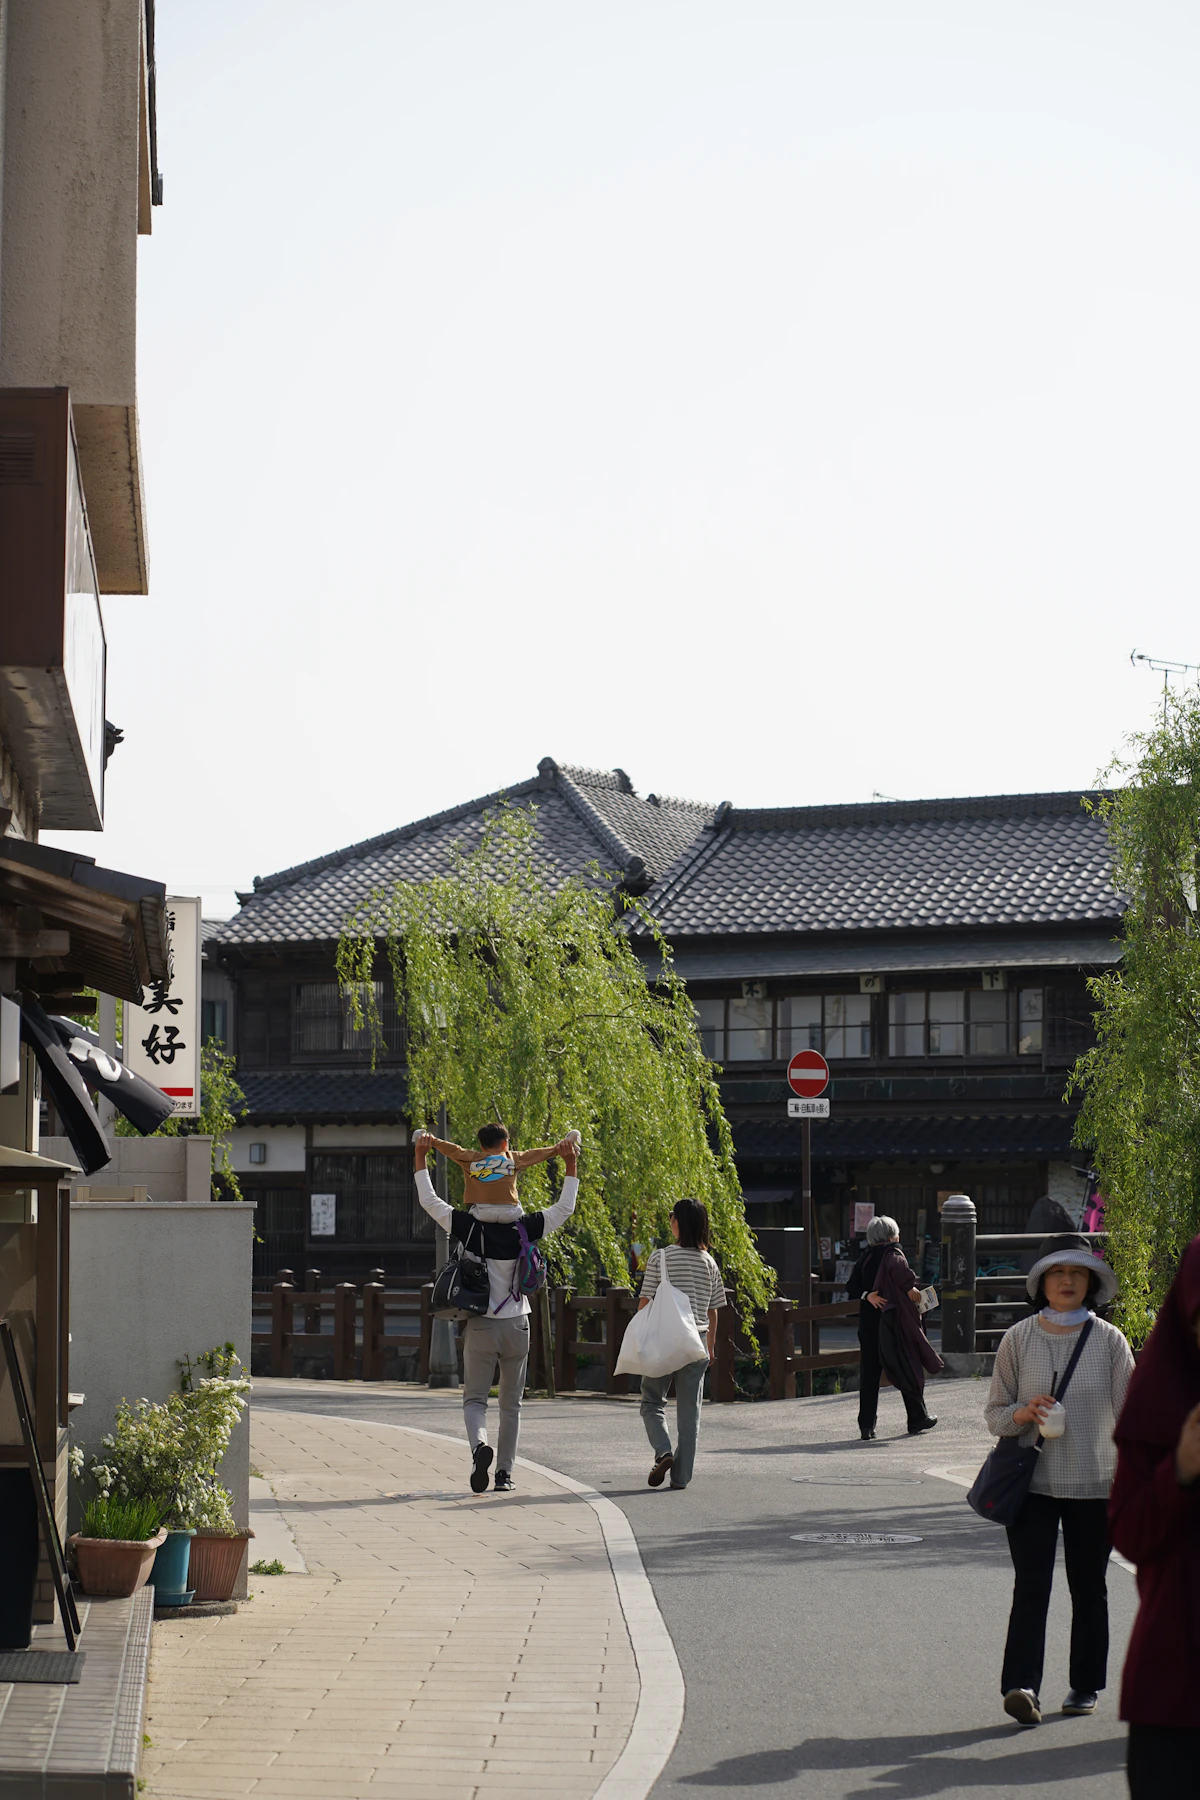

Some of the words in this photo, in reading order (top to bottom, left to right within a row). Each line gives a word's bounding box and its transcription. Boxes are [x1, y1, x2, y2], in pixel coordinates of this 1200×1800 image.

[984, 970, 1000, 988] 下
[142, 980, 186, 1065] 美好
[172, 1101, 193, 1110] ります
